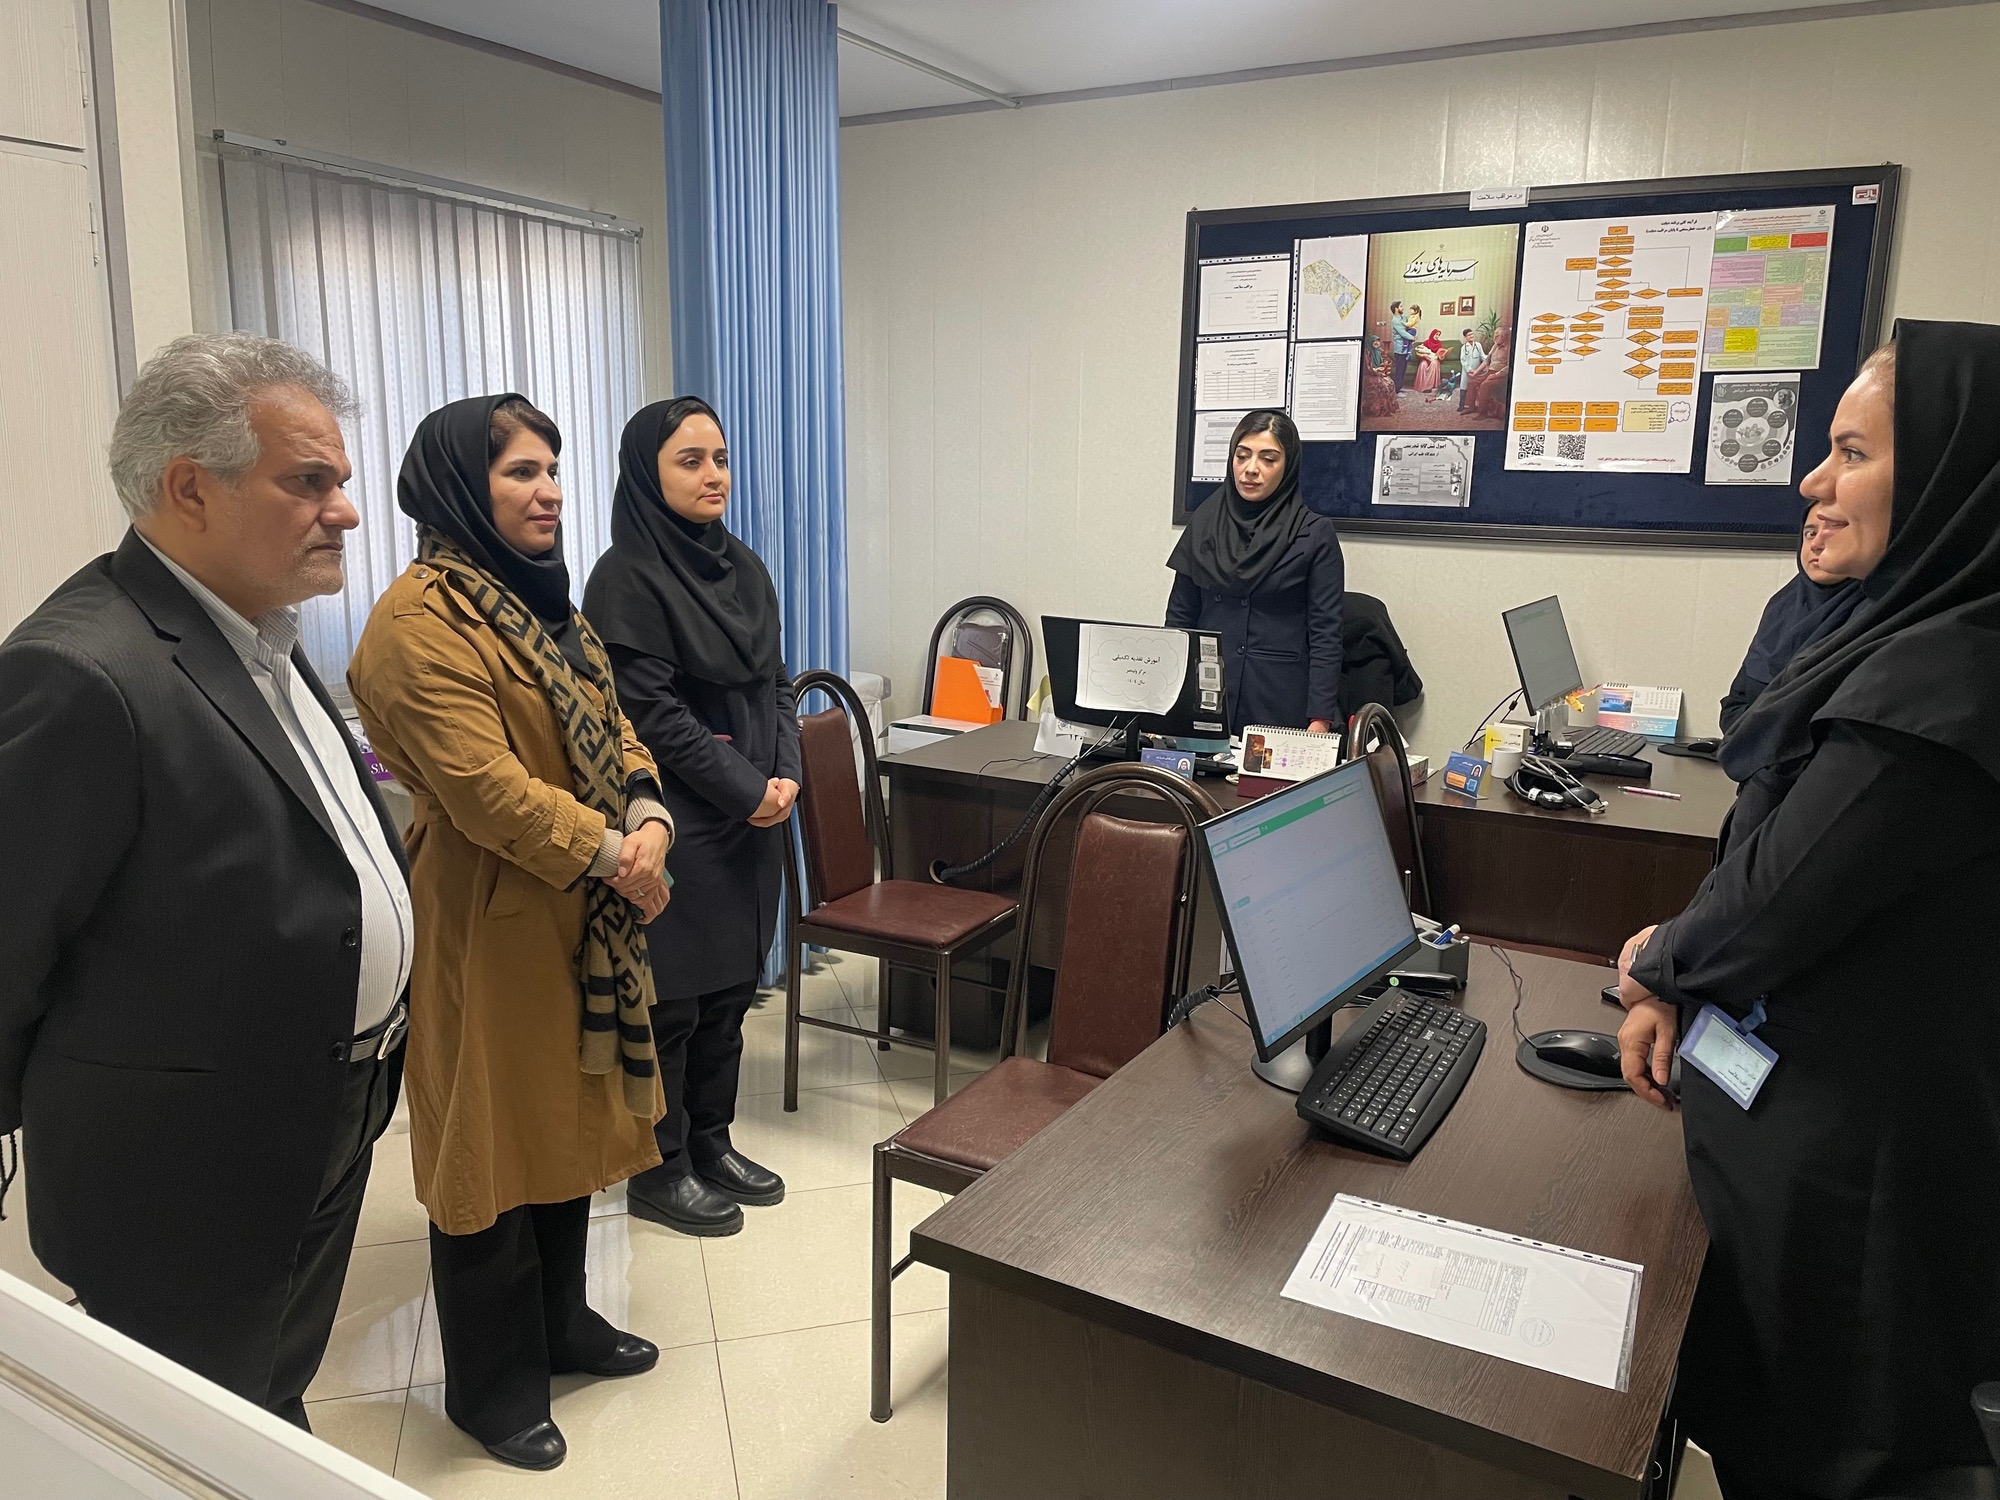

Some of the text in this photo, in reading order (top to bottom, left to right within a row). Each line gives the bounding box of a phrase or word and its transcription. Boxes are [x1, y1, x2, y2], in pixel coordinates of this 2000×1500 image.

[1476, 193, 1495, 201] سلامت
[1496, 192, 1513, 200] مراقب
[1403, 250, 1438, 278] زندگی
[1144, 656, 1161, 665] آموزش
